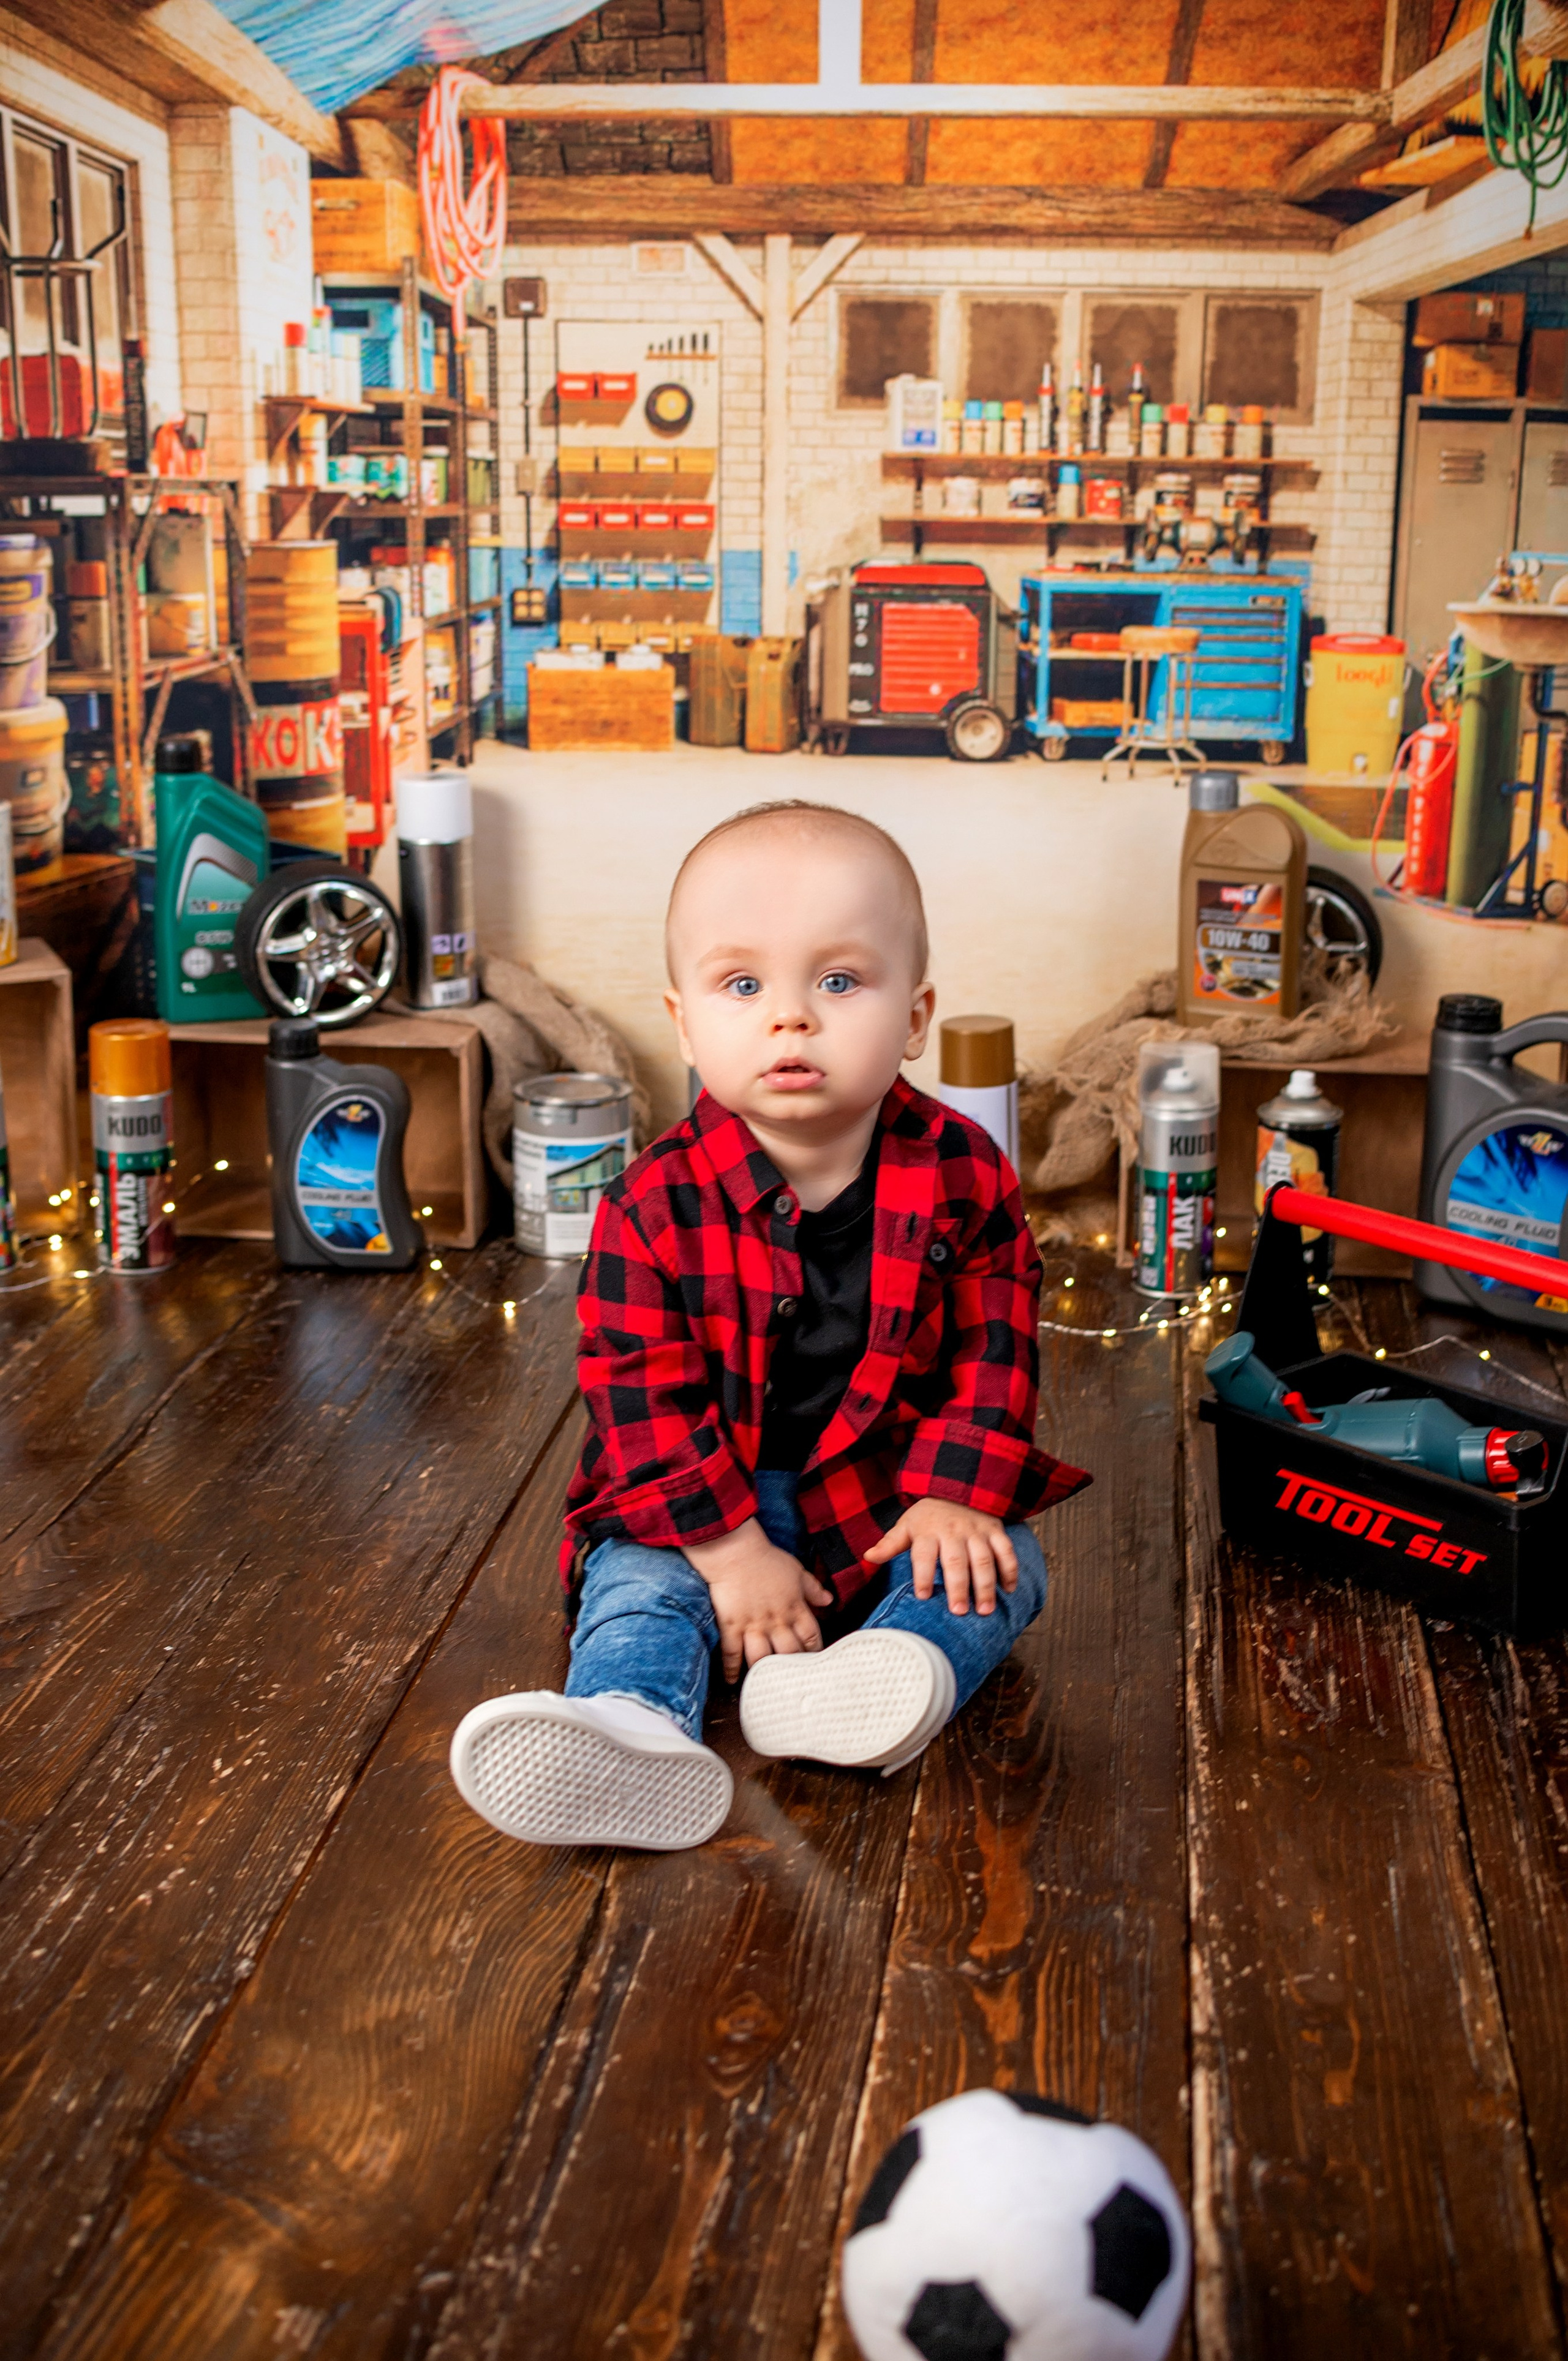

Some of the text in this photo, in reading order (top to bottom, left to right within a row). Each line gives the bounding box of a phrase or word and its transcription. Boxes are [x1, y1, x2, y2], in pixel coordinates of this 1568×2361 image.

[1208, 929, 1270, 951] 10W-40
[108, 1115, 160, 1137] KUDO
[115, 1173, 140, 1261] ЭМАЛЬ
[1172, 1195, 1194, 1251] ЛАК
[1449, 1206, 1510, 1229] COOLING
[1513, 1220, 1558, 1241] FLUID
[1275, 1468, 1488, 1575] TOOL SET
